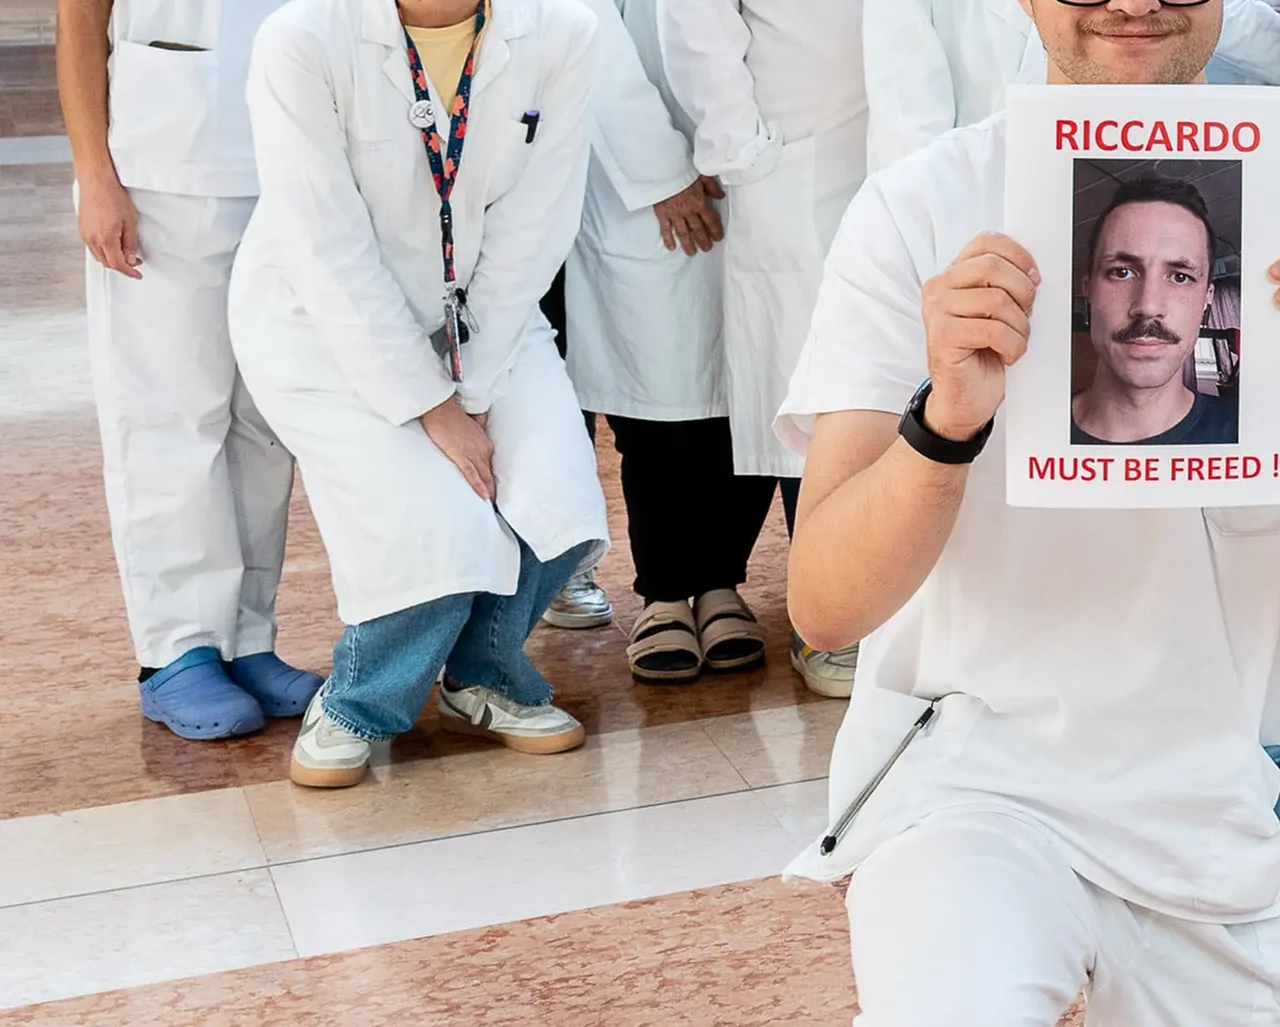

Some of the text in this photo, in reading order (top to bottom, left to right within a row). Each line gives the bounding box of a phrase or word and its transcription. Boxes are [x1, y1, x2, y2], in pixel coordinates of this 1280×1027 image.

[1055, 118, 1262, 153] RICCARDO
[1028, 455, 1116, 483] MUST
[1123, 457, 1160, 482] BE
[1169, 455, 1263, 482] FREED
